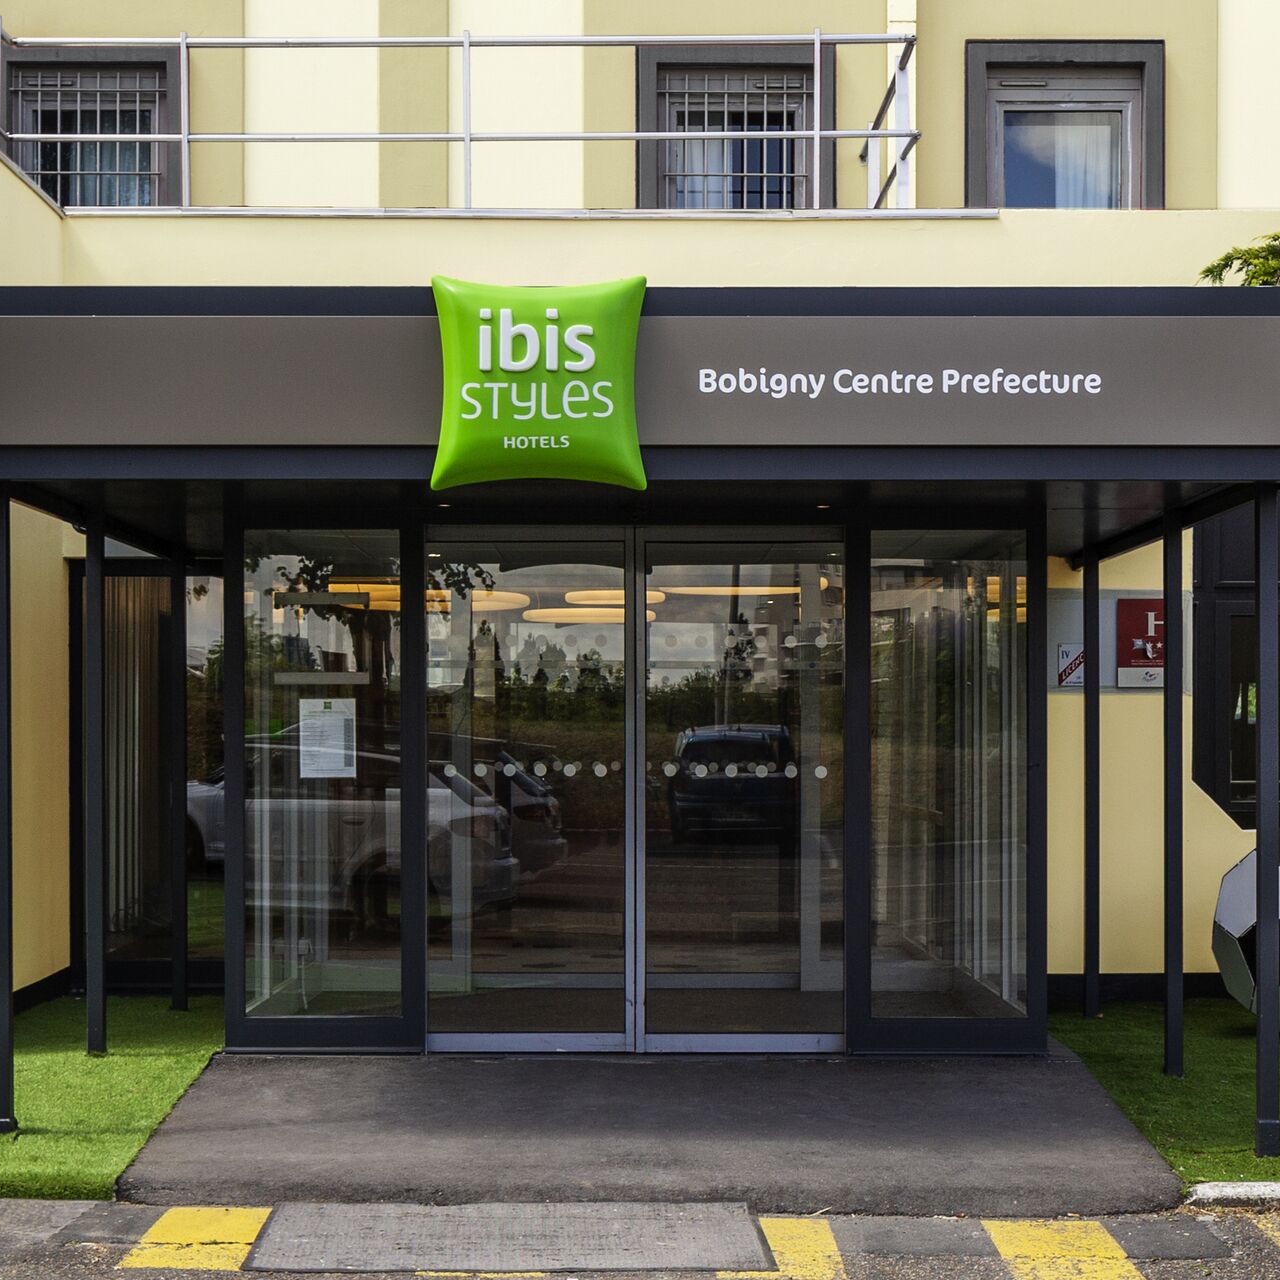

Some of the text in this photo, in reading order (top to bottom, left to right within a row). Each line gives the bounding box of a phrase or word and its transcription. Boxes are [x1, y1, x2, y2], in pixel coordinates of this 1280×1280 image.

[479, 308, 596, 372] ibis
[698, 367, 1102, 399] Bobigny Centre Prefecture
[503, 435, 570, 449] HOTELS
[1061, 650, 1070, 659] IV
[1061, 652, 1085, 680] LICENC
